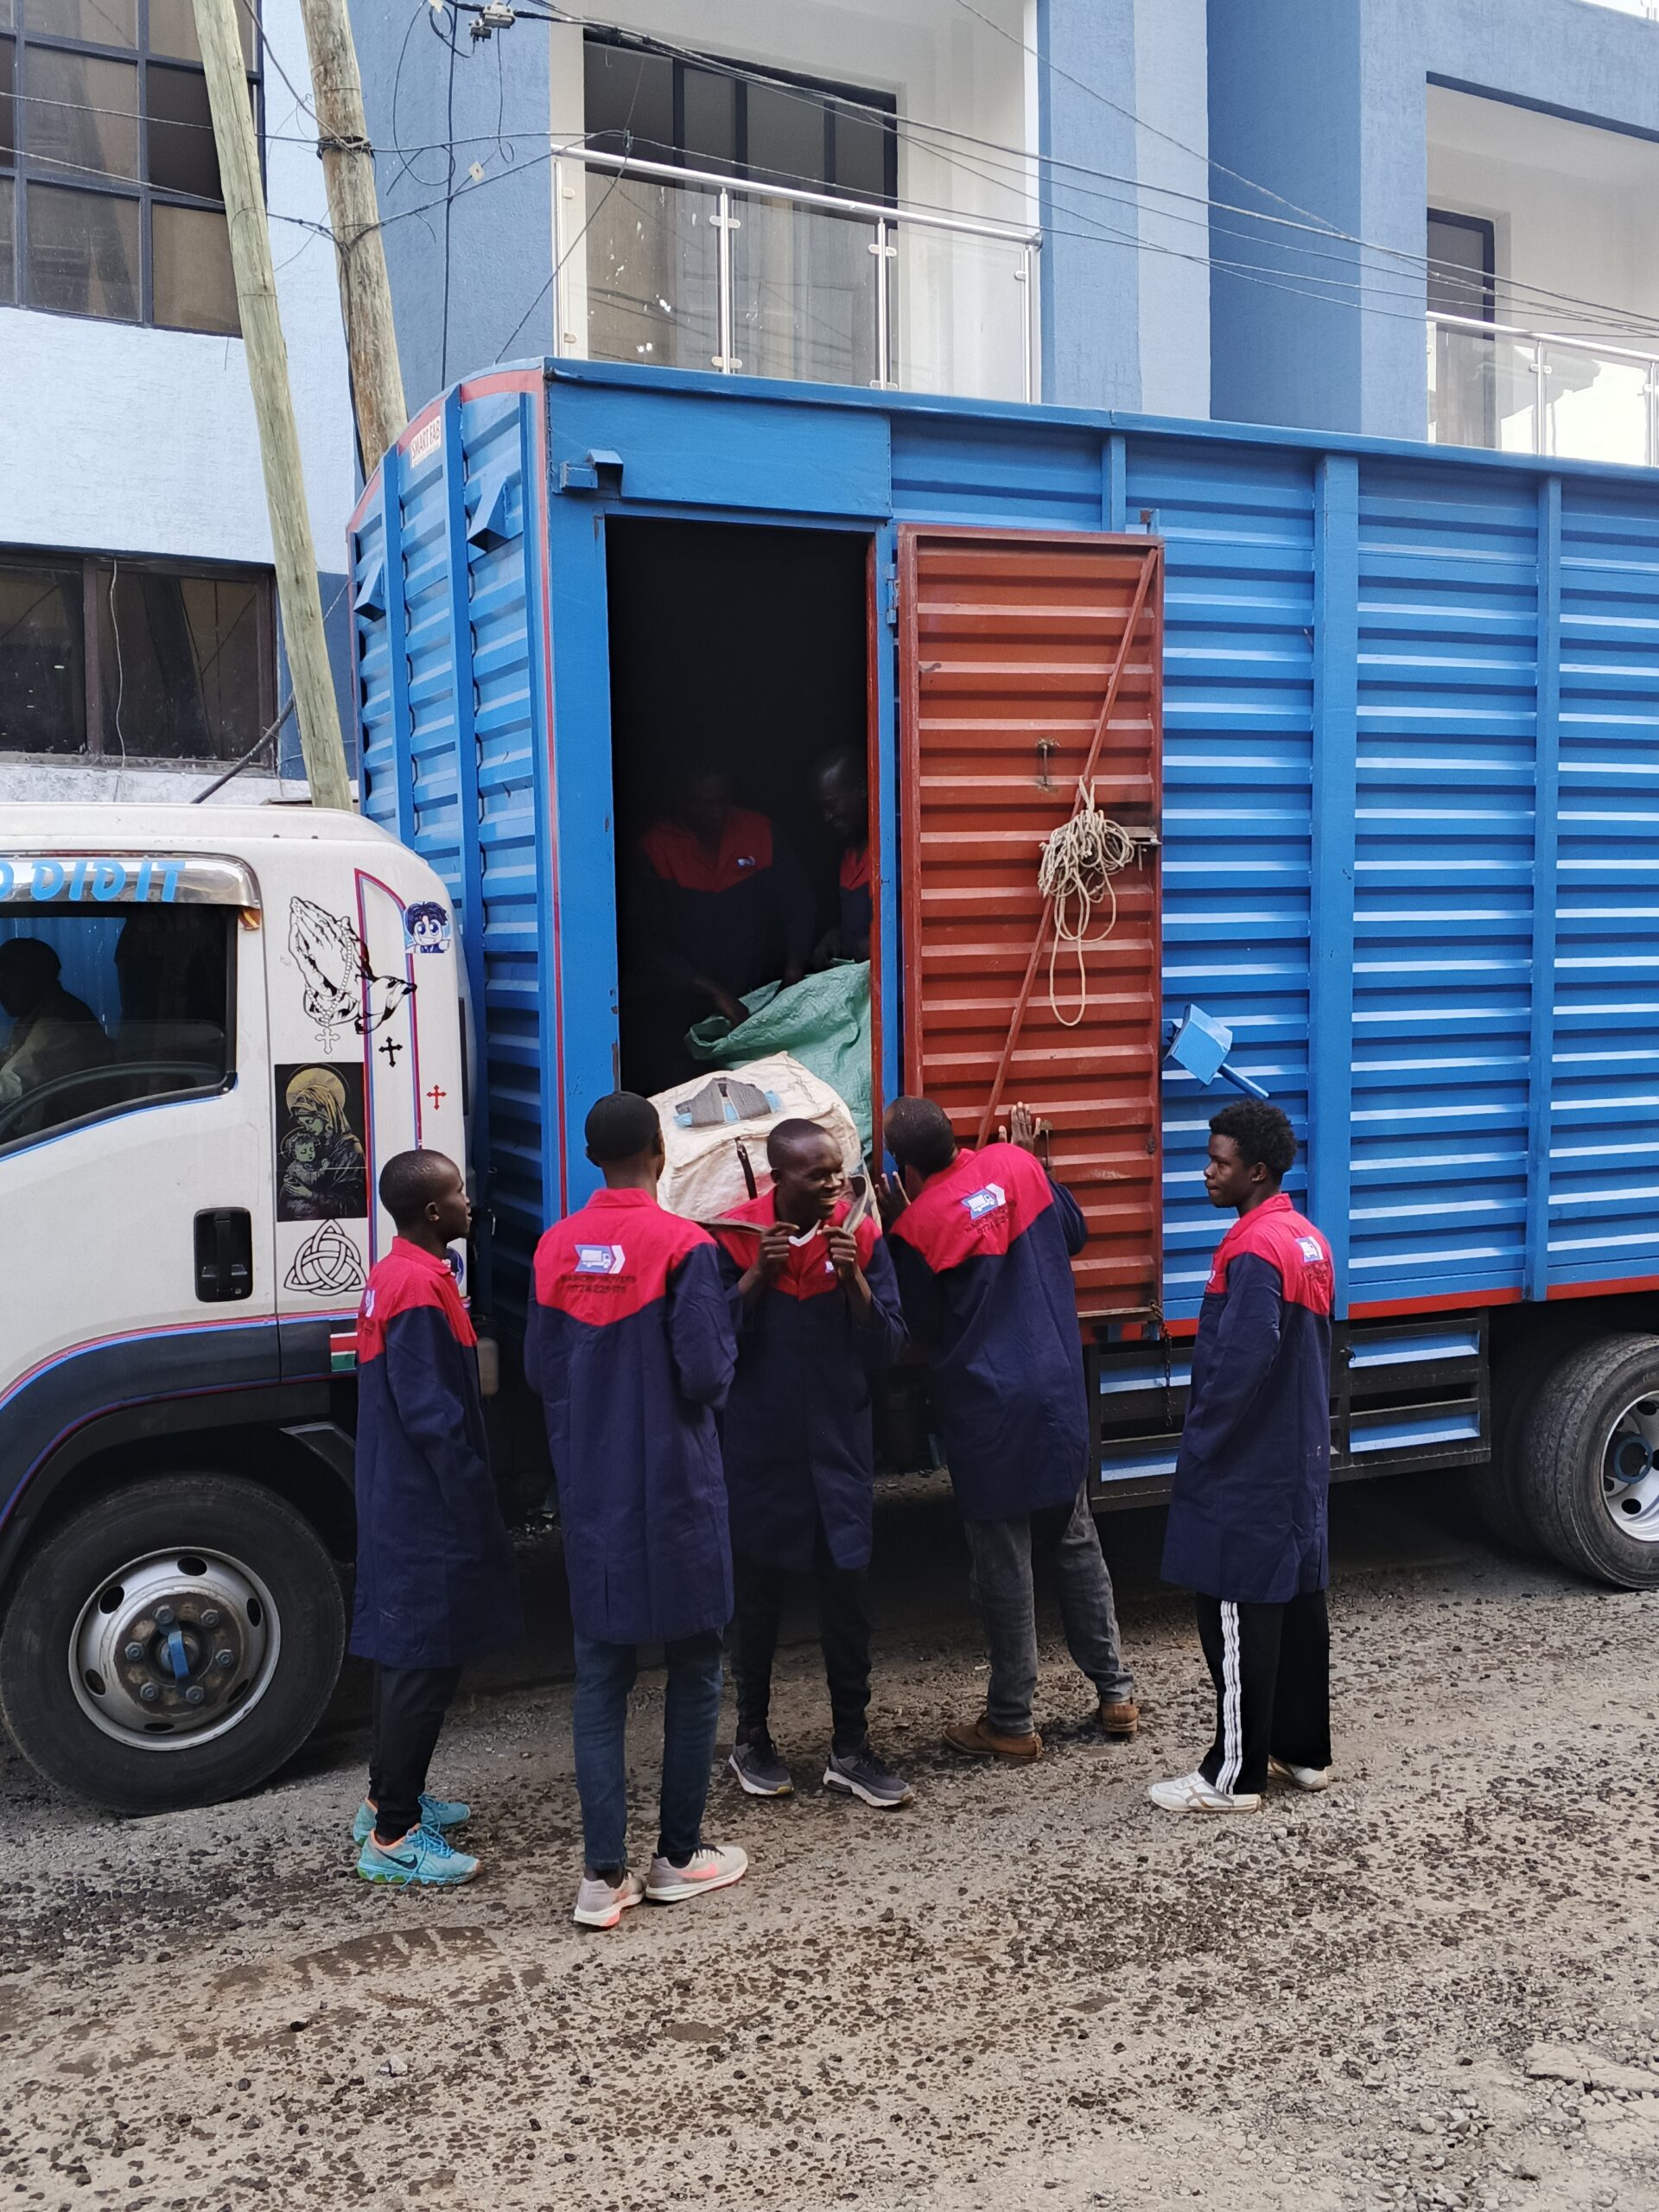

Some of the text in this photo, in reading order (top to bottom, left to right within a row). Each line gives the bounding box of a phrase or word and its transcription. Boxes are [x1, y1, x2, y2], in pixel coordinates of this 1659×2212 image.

[411, 428, 429, 460] SMART
[30, 860, 125, 900] DID
[135, 861, 186, 902] IT
